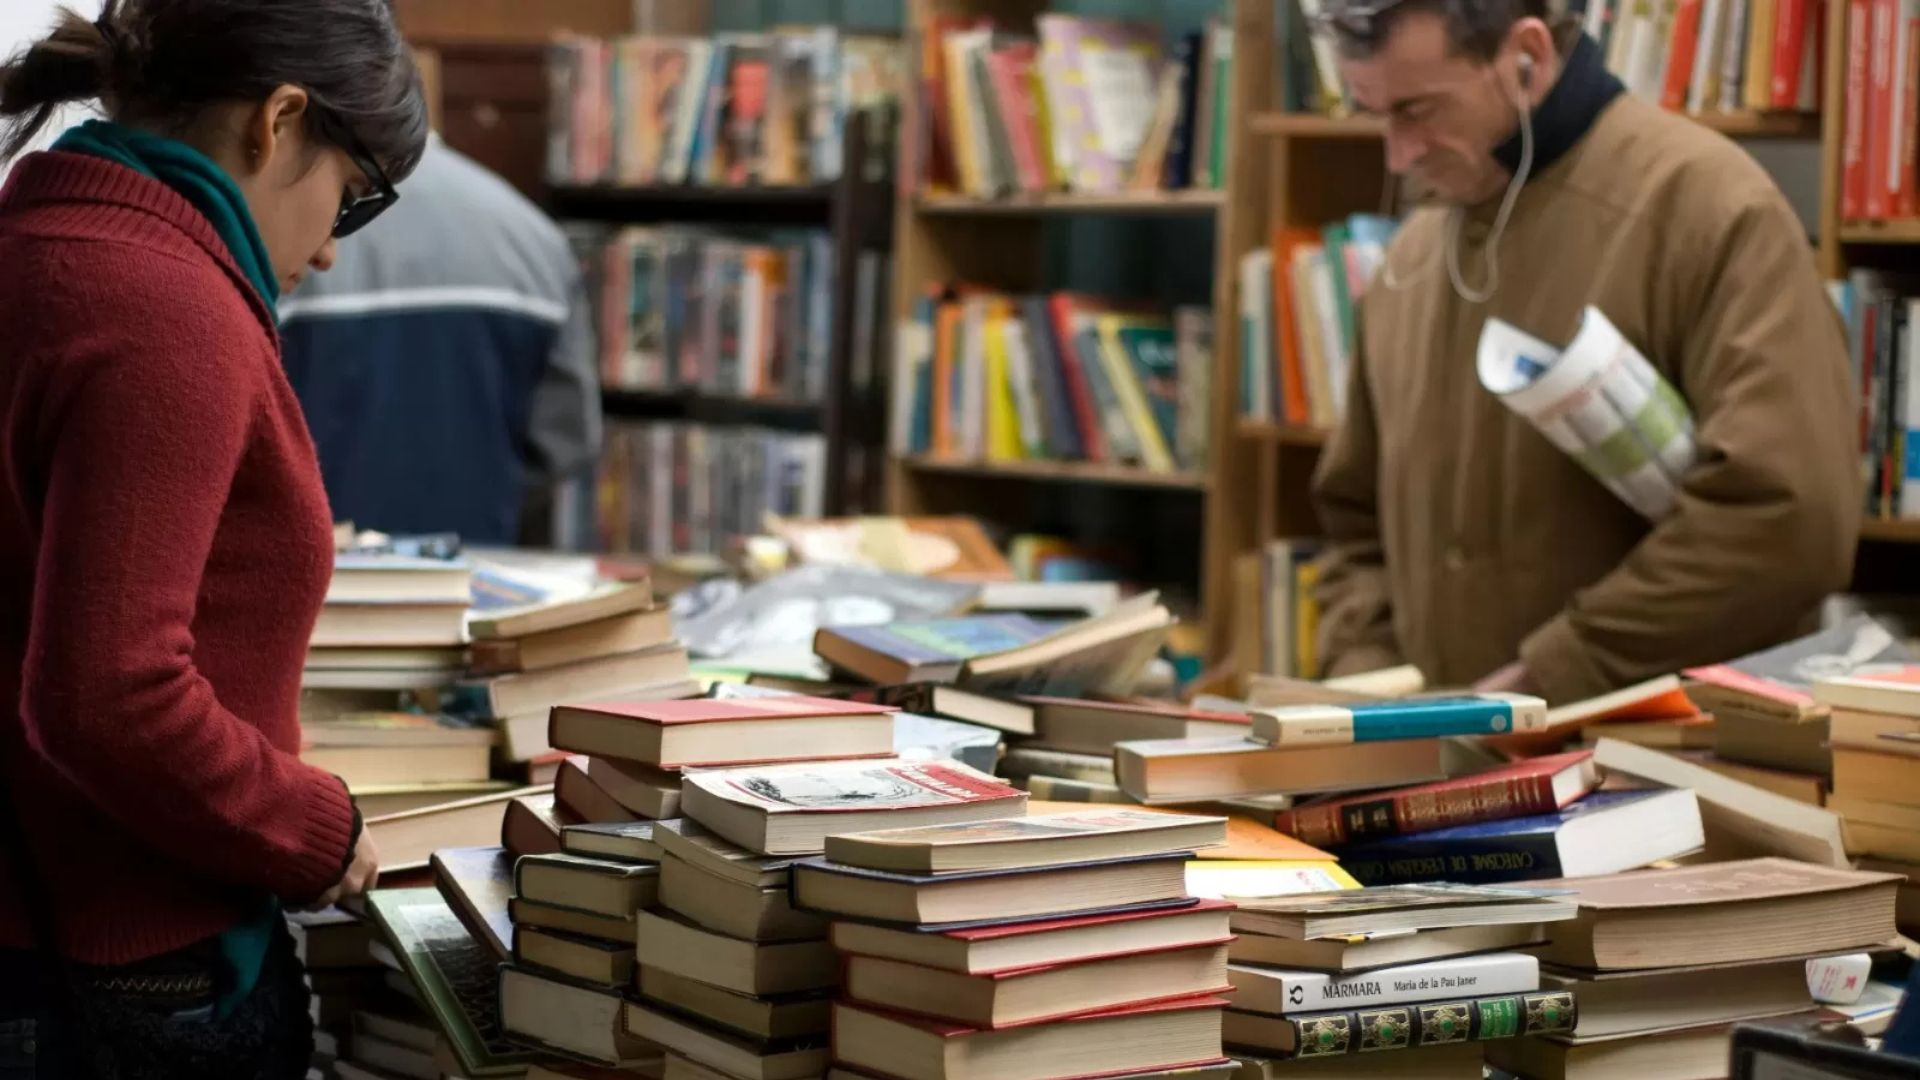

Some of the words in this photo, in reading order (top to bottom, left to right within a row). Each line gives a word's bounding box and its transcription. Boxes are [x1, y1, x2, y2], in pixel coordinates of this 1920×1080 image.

[1450, 856, 1467, 872] DE
[1471, 851, 1534, 870] CATECISME
[1393, 980, 1417, 992] Maria
[1418, 978, 1429, 989] de
[1431, 977, 1439, 988] la
[1441, 977, 1456, 988] Pau
[1457, 976, 1477, 987] Janer
